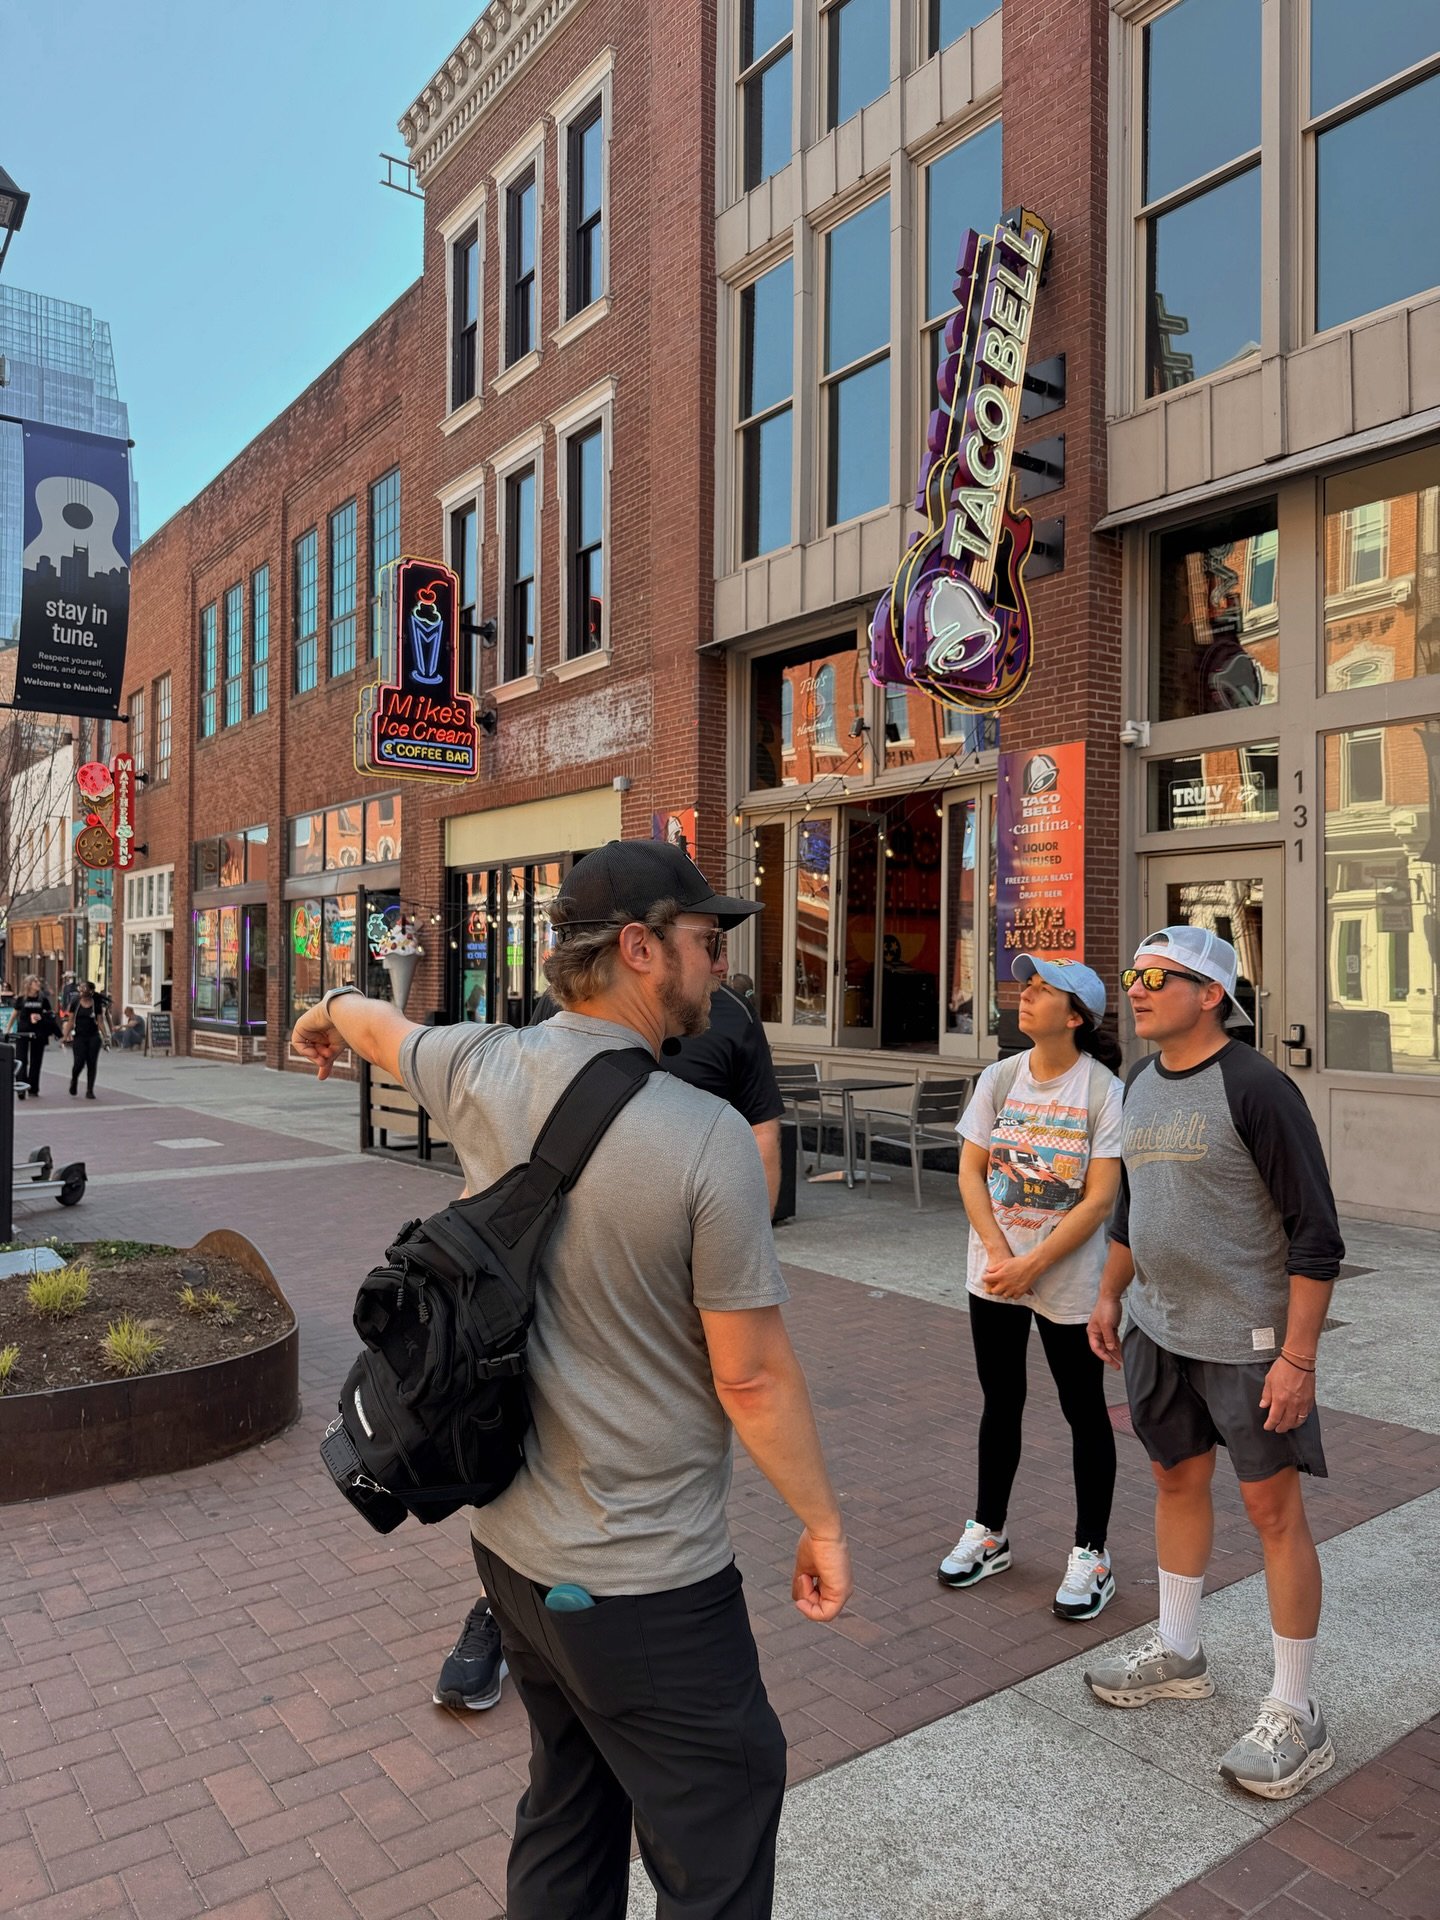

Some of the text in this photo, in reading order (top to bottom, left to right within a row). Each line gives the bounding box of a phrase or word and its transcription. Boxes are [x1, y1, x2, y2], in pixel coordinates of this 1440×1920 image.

[943, 227, 1043, 562] TACO BELL
[45, 599, 108, 626] stay in
[52, 623, 98, 648] tune.
[38, 651, 104, 668] Respect yourself,
[32, 662, 60, 673] others,
[61, 666, 77, 674] and
[92, 670, 108, 680] city.
[23, 676, 61, 688] Welcome
[73, 683, 113, 694] Nashville!
[800, 674, 828, 694] Tito's
[387, 693, 467, 726] Mike's
[380, 716, 473, 746] Ice Cream
[396, 743, 442, 761] COFFEE
[445, 750, 470, 765] BAR
[1020, 793, 1060, 807] TACO
[1173, 785, 1224, 806] TRULY
[1022, 805, 1062, 818] BELL
[1012, 815, 1069, 835] cantina
[1023, 842, 1058, 853] LIQUOR
[1021, 855, 1062, 866] INFUSED
[1005, 875, 1029, 885] FREEZE
[1050, 873, 1073, 881] BLAST
[1019, 890, 1063, 899] DRAFT BEER
[1013, 907, 1064, 927] LIVE
[1004, 930, 1075, 949] MUSIC
[1121, 1108, 1208, 1153] Vanderbilt
